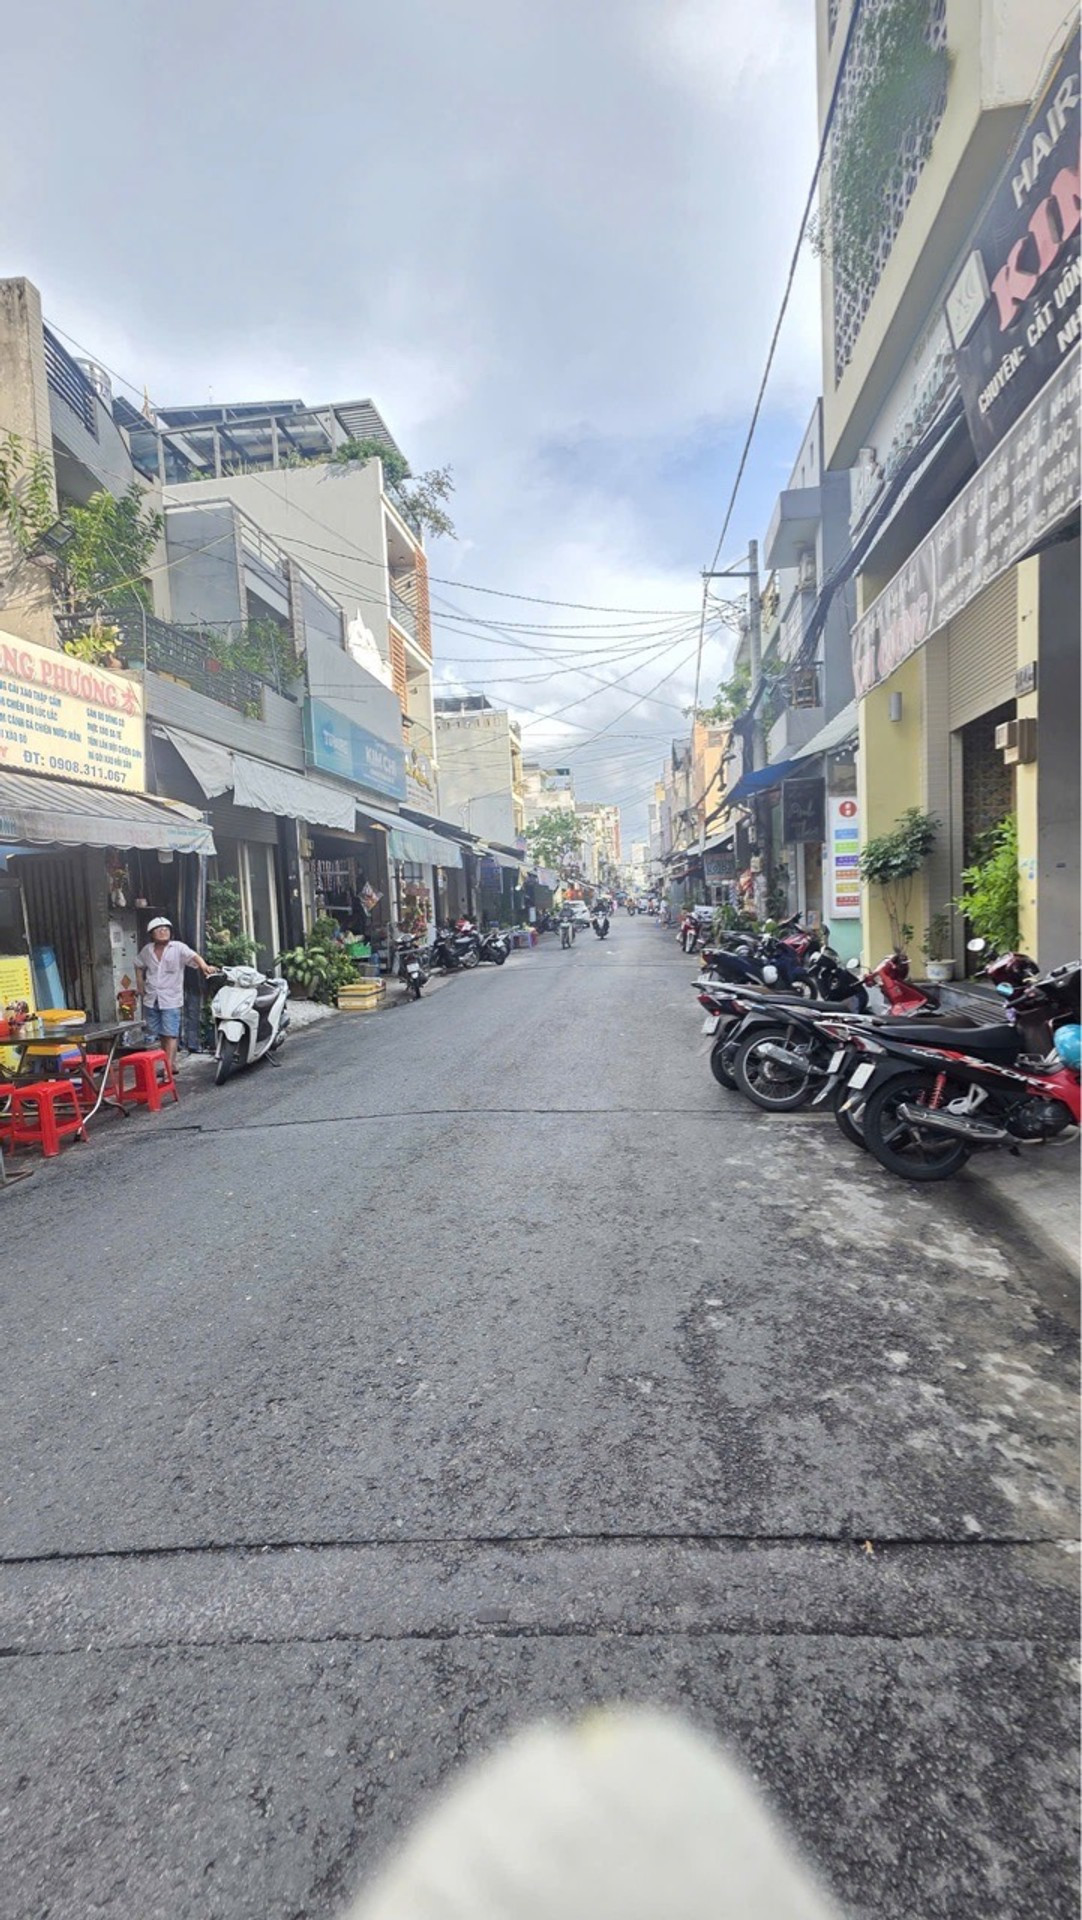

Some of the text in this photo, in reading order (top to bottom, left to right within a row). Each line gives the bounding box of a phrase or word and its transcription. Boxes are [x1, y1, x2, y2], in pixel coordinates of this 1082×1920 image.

[1011, 73, 1080, 209] HAIR
[978, 345, 1027, 414] CHUYÊN:
[1026, 301, 1055, 348] CẮT
[1043, 445, 1078, 496] NHẬN
[40, 659, 117, 708] PHƯƠNG
[23, 750, 127, 783] ĐT: 0908.311.067
